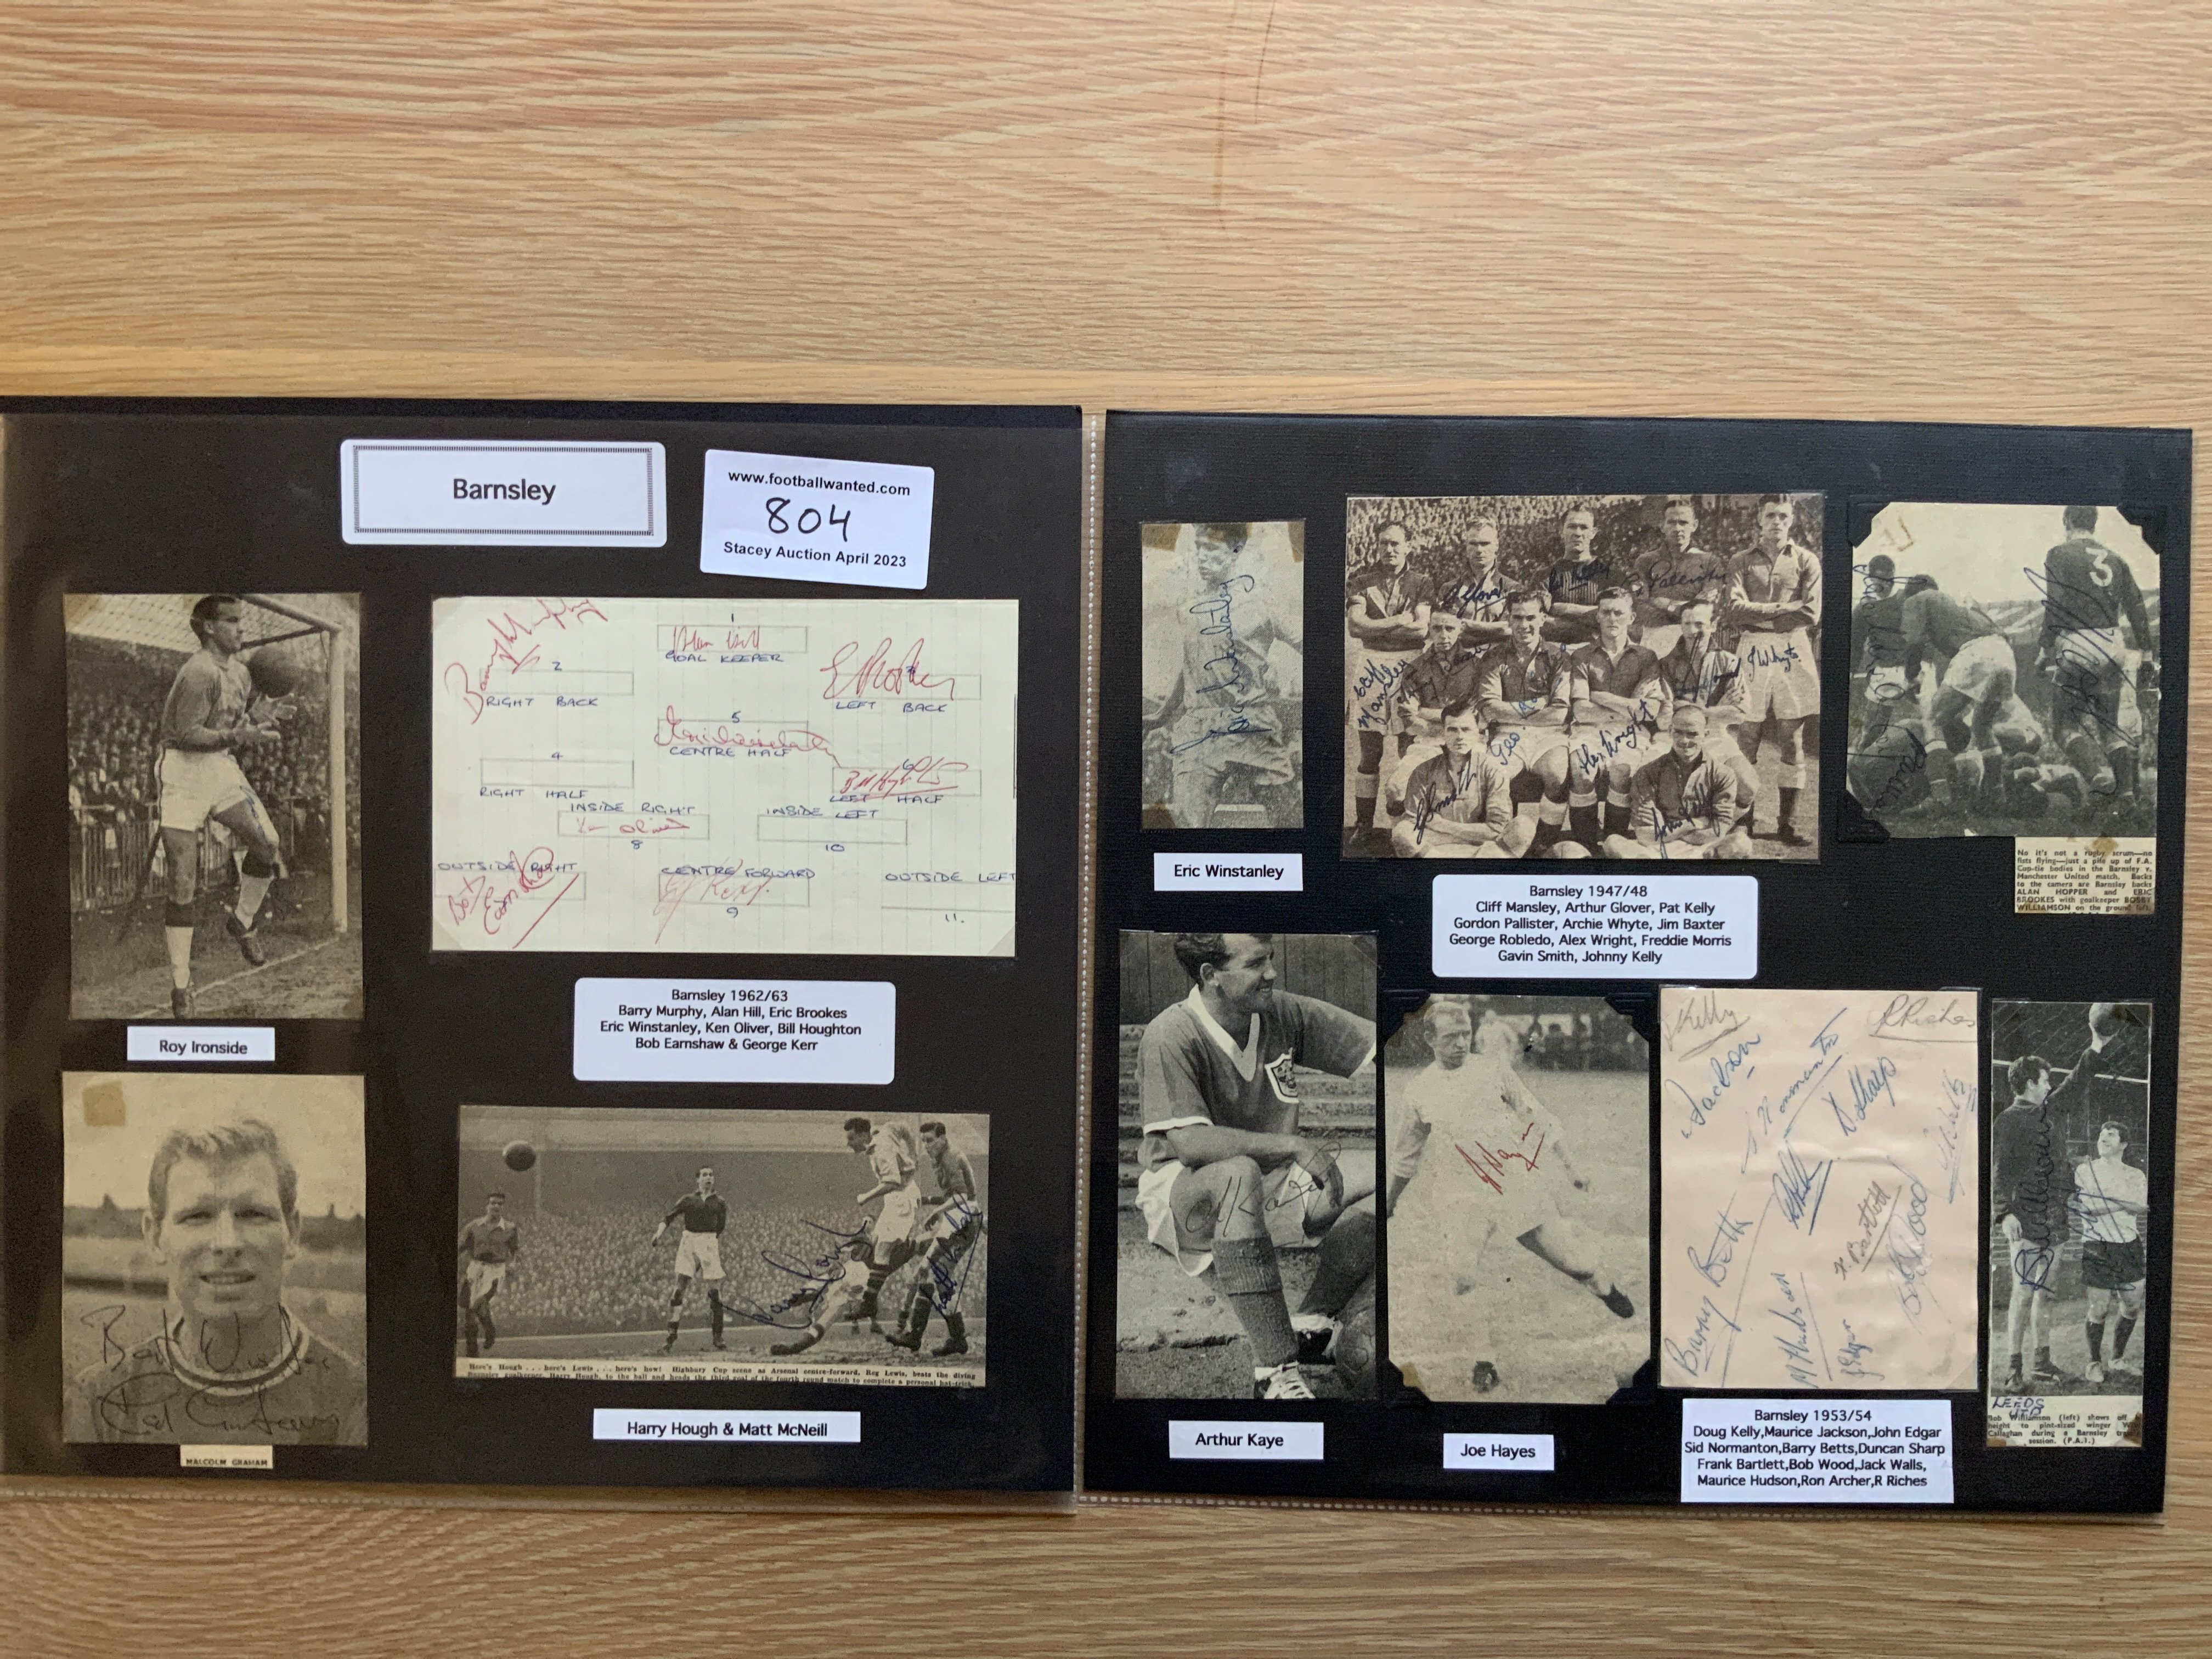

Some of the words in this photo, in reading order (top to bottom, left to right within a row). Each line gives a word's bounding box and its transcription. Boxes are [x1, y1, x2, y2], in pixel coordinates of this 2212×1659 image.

[728, 472, 910, 496] www.footballwanted.com
[453, 478, 556, 506] Barnsley
[765, 497, 851, 543] 804
[724, 541, 772, 559] Stacey
[776, 546, 831, 561] Auction
[835, 551, 869, 566] April
[873, 554, 906, 567] 2023
[2085, 546, 2113, 587] 3
[665, 652, 706, 663] GOAL
[720, 653, 785, 663] KEEPER
[552, 662, 563, 671] 2
[487, 697, 535, 707] RIGHT
[557, 697, 599, 707] BACK
[836, 701, 877, 710] LEFT
[903, 702, 948, 713] BACK
[732, 712, 741, 723] 5
[670, 747, 735, 757] CENTRE
[748, 748, 791, 758] HALF
[480, 788, 524, 797] RIGHT
[546, 790, 589, 799] HALF
[830, 794, 871, 803] LEFT
[898, 794, 944, 804] HALF
[571, 803, 624, 812] INSIDE
[641, 805, 696, 814] RIGHT
[767, 808, 823, 816] INSIDE
[835, 810, 879, 819] LEFT
[631, 839, 641, 849] 8
[825, 843, 845, 852] 10
[438, 862, 515, 871] OUTSIDE
[531, 862, 578, 872] RIGHT
[662, 866, 735, 876] CENTRE
[745, 868, 816, 880] FORWARD
[1174, 864, 1200, 877] Eric
[1205, 864, 1284, 881] Winstanley
[885, 873, 963, 882] OUTSIDE
[979, 873, 1016, 883] LEFT
[1530, 885, 1583, 899] Barnsley
[1588, 885, 1647, 897] 1947/48
[727, 907, 739, 918] 9
[1476, 900, 1502, 913] Cliff
[1506, 901, 1560, 916] Mansley,
[1565, 901, 1607, 913] Arthur
[1610, 901, 1655, 915] Glover,
[1659, 902, 1680, 913] Pat
[1684, 901, 1716, 916] Kelly
[1454, 917, 1500, 929] Gordon
[1504, 917, 1558, 931] Pallister,
[1562, 917, 1603, 929] Archie
[1607, 917, 1652, 932] Whyte,
[1657, 918, 1679, 930] Jim
[1683, 918, 1725, 930] Baxter
[1449, 933, 1496, 948] George
[1499, 933, 1554, 947] Robledo,
[1559, 934, 1587, 946] Alex
[1590, 934, 1637, 949] Wright,
[1641, 934, 1689, 946] Freddie
[1692, 934, 1732, 946] Morris
[1498, 950, 1533, 962] Gavin
[1537, 950, 1578, 964] Smith,
[1582, 950, 1628, 965] Johnny
[1632, 950, 1663, 965] Kelly
[672, 989, 726, 1003] Barnsley
[731, 990, 788, 1002] 1962/63
[619, 1005, 653, 1019] Barry
[656, 1005, 707, 1020] Murphy,
[710, 1005, 739, 1017] Alan
[743, 1006, 765, 1020] Hill,
[769, 1006, 792, 1018] Eric
[796, 1007, 848, 1019] Brookes
[600, 1020, 624, 1032] Eric
[628, 1021, 701, 1036] Winstanley,
[706, 1022, 730, 1034] Ken
[733, 1022, 773, 1036] Oliver,
[777, 1022, 795, 1034] Bill
[799, 1023, 861, 1037] Houghton
[159, 1040, 187, 1056] Roy
[191, 1041, 248, 1054] Ironside
[635, 1037, 660, 1049] Bob
[664, 1037, 725, 1049] Earnshaw
[728, 1038, 738, 1050] &
[742, 1038, 787, 1053] George
[791, 1039, 819, 1051] Kerr
[1992, 1397, 2045, 1409] LEEDS
[1754, 1409, 1809, 1424] Barnsley
[1814, 1409, 1872, 1422] 1953/54
[627, 1421, 667, 1438] Harry
[672, 1421, 718, 1438] Hough
[723, 1422, 733, 1436] &
[739, 1423, 773, 1436] Matt
[777, 1423, 827, 1437] McNeill
[1694, 1425, 1726, 1440] Doug
[1731, 1425, 1813, 1440] Kelly,Maurice
[1816, 1426, 1901, 1440] Jackson,John
[1905, 1426, 1942, 1441] Edgar
[1195, 1432, 1244, 1446] Arthur
[1248, 1433, 1284, 1449] Kaye
[1460, 1443, 1486, 1457] Joe
[1491, 1443, 1536, 1461] Hayes
[1684, 1441, 1704, 1453] Sid
[1708, 1442, 1816, 1457] Normanton,Barry
[1820, 1442, 1904, 1456] Betts,Duncan
[1909, 1442, 1945, 1457] Sharp
[1697, 1458, 1733, 1470] Frank
[1736, 1458, 1814, 1471] Bartlett,Bob
[1818, 1458, 1886, 1472] Wood,Jack
[1889, 1458, 1927, 1472] Walls,
[1697, 1474, 1746, 1486] Maurice
[1750, 1474, 1825, 1488] Hudson,Ron
[1829, 1474, 1883, 1488] Archer,R
[1886, 1475, 1928, 1487] Riches
